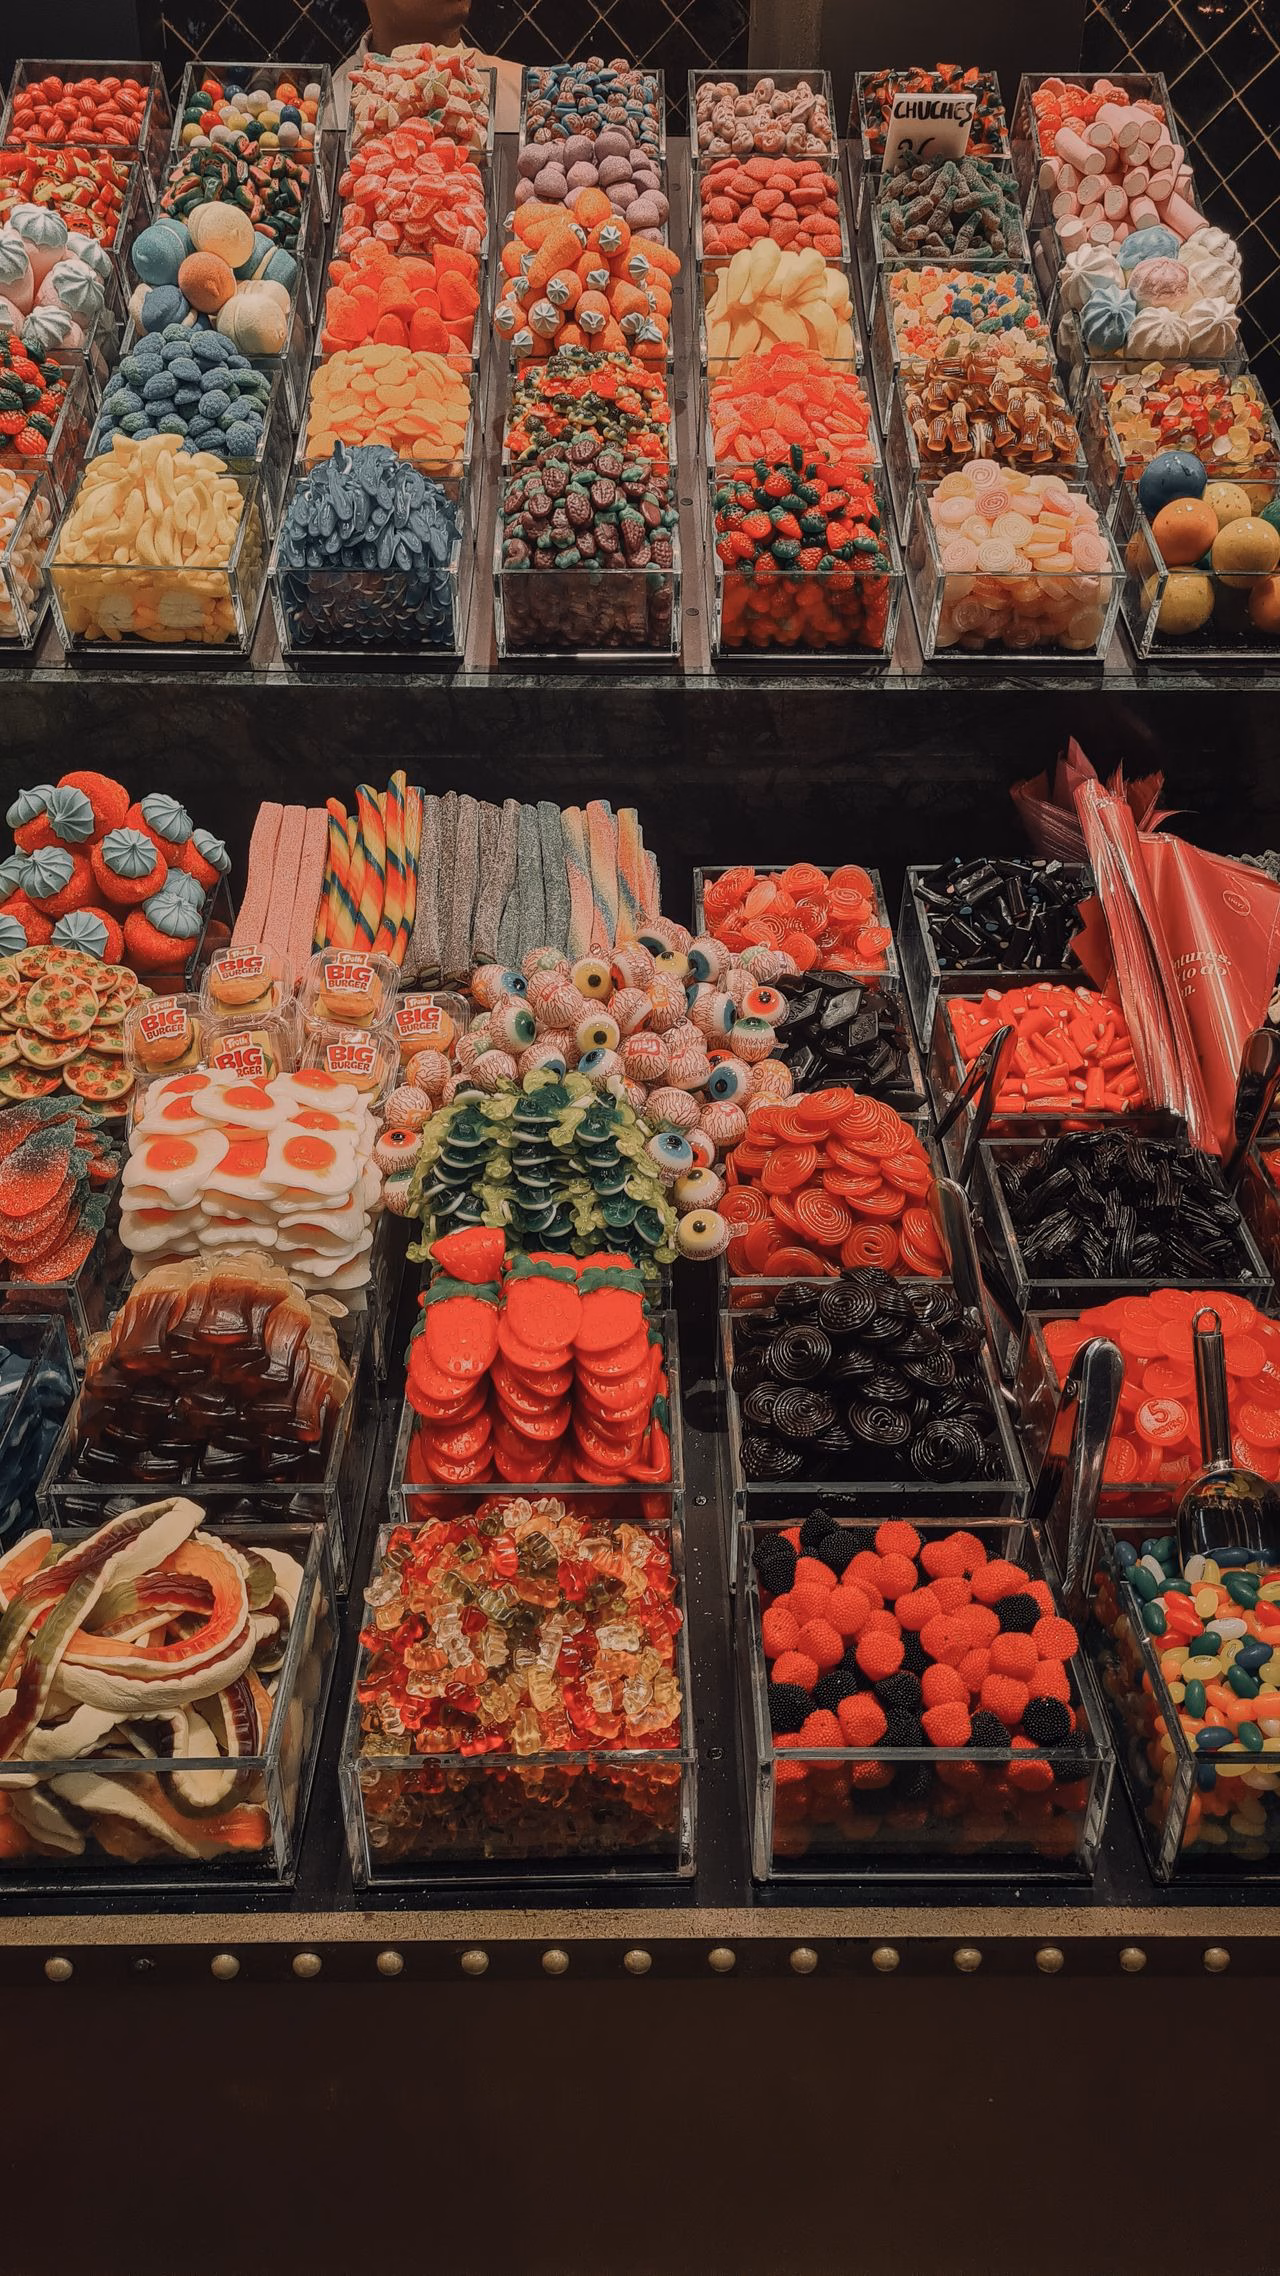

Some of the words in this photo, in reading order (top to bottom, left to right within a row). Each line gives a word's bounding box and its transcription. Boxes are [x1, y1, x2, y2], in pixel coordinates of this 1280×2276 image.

[894, 101, 975, 127] CHUCHES
[218, 957, 263, 972] BIG
[222, 967, 261, 979] BURGER
[326, 966, 373, 982] BIG
[328, 979, 368, 990] BURGER
[140, 1010, 186, 1033] BIG
[396, 1008, 440, 1026] BIG
[146, 1023, 185, 1040] BURGER
[400, 1022, 439, 1034] BURGER
[215, 1048, 262, 1069] BIG
[327, 1046, 374, 1063] BIG
[236, 1064, 263, 1077] RGER
[331, 1060, 371, 1071] BURGER
[1147, 1400, 1169, 1423] 5
